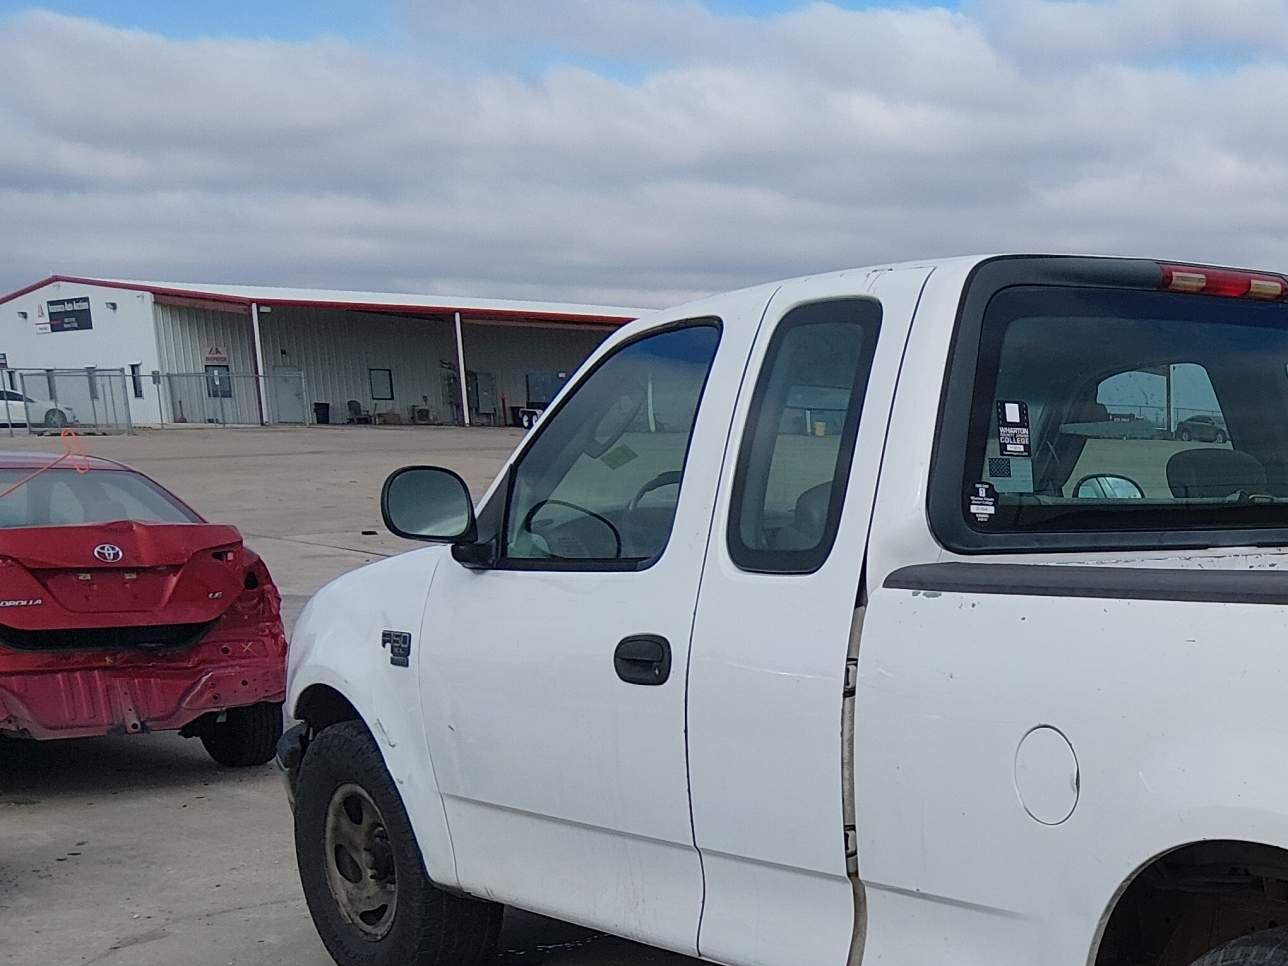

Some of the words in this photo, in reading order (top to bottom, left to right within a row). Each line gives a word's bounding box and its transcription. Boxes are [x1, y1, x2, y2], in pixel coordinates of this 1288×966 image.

[999, 427, 1029, 435] WHARTON
[1000, 437, 1029, 445] COLLEGE
[0, 599, 42, 607] OROLLA
